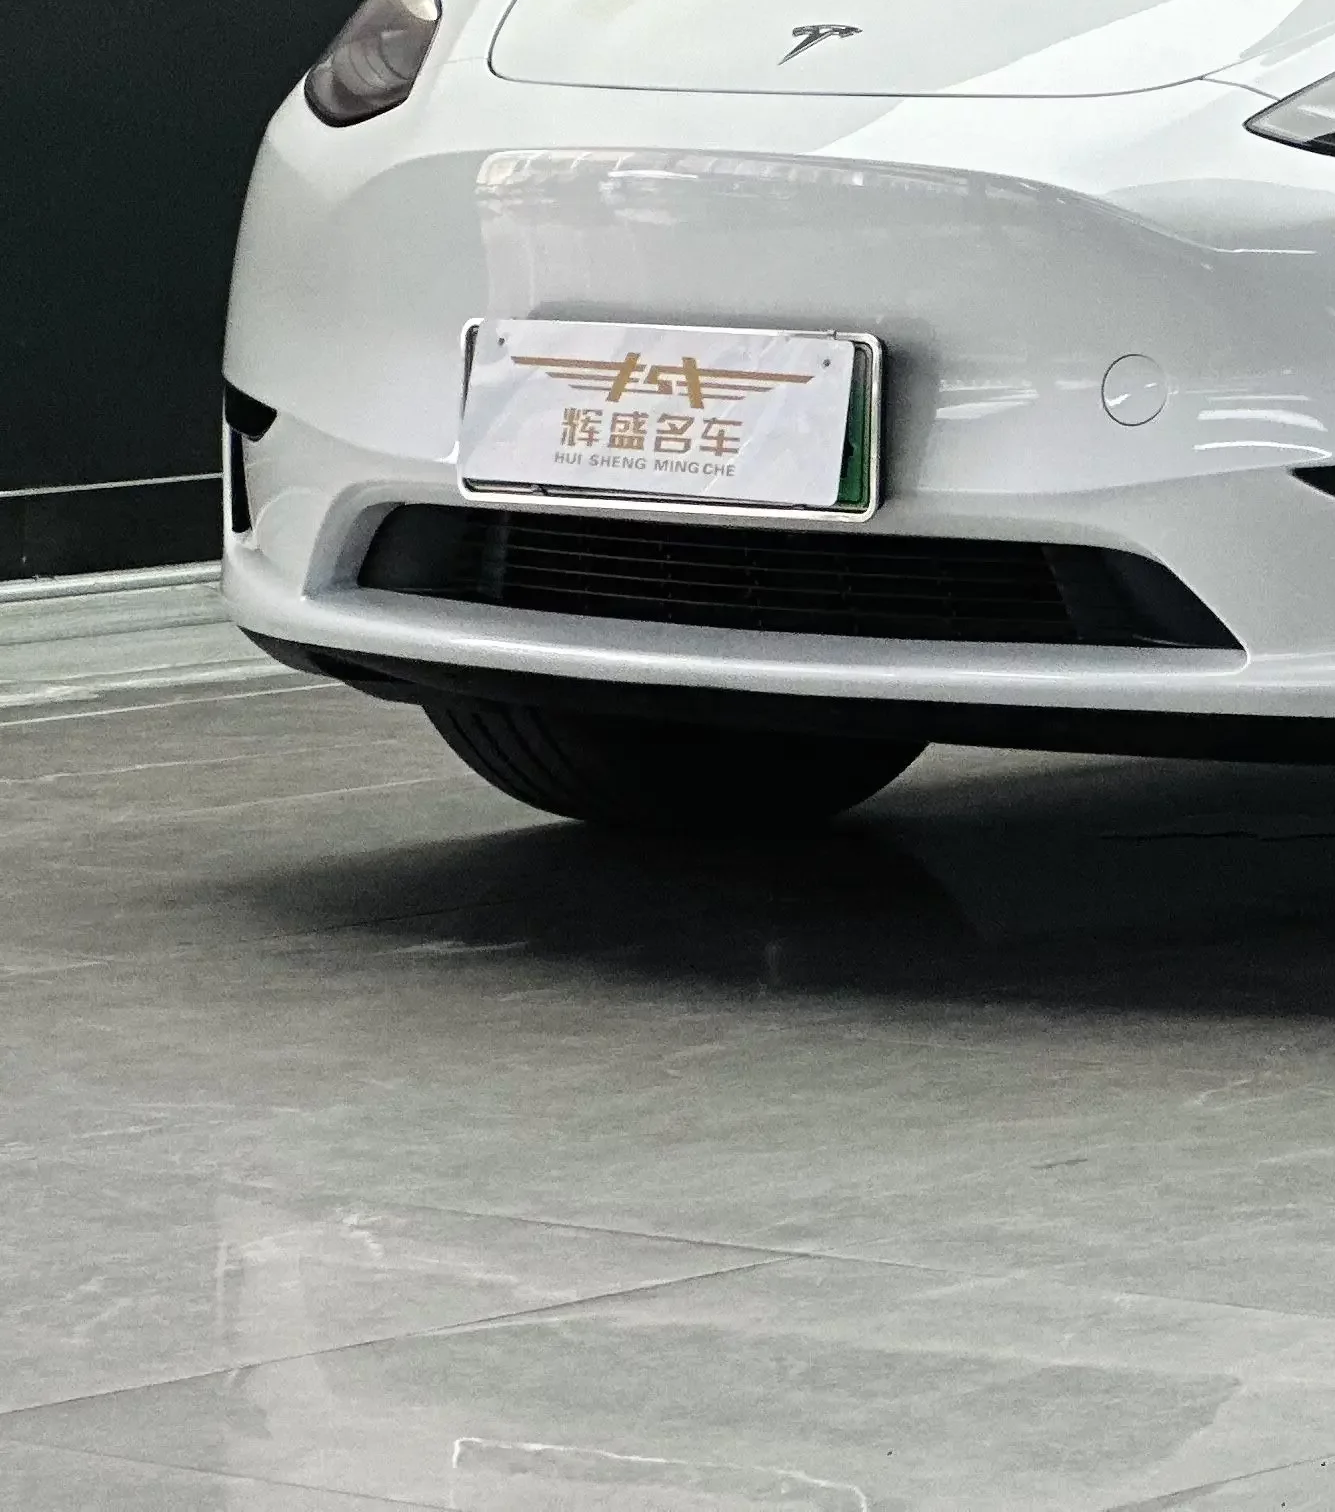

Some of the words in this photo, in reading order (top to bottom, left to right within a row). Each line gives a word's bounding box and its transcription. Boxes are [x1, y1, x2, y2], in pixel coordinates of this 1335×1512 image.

[562, 407, 743, 457] 辉盛名车
[554, 451, 583, 466] HUI
[588, 454, 647, 471] SHENG
[654, 459, 699, 474] MING
[702, 463, 736, 478] CHE
